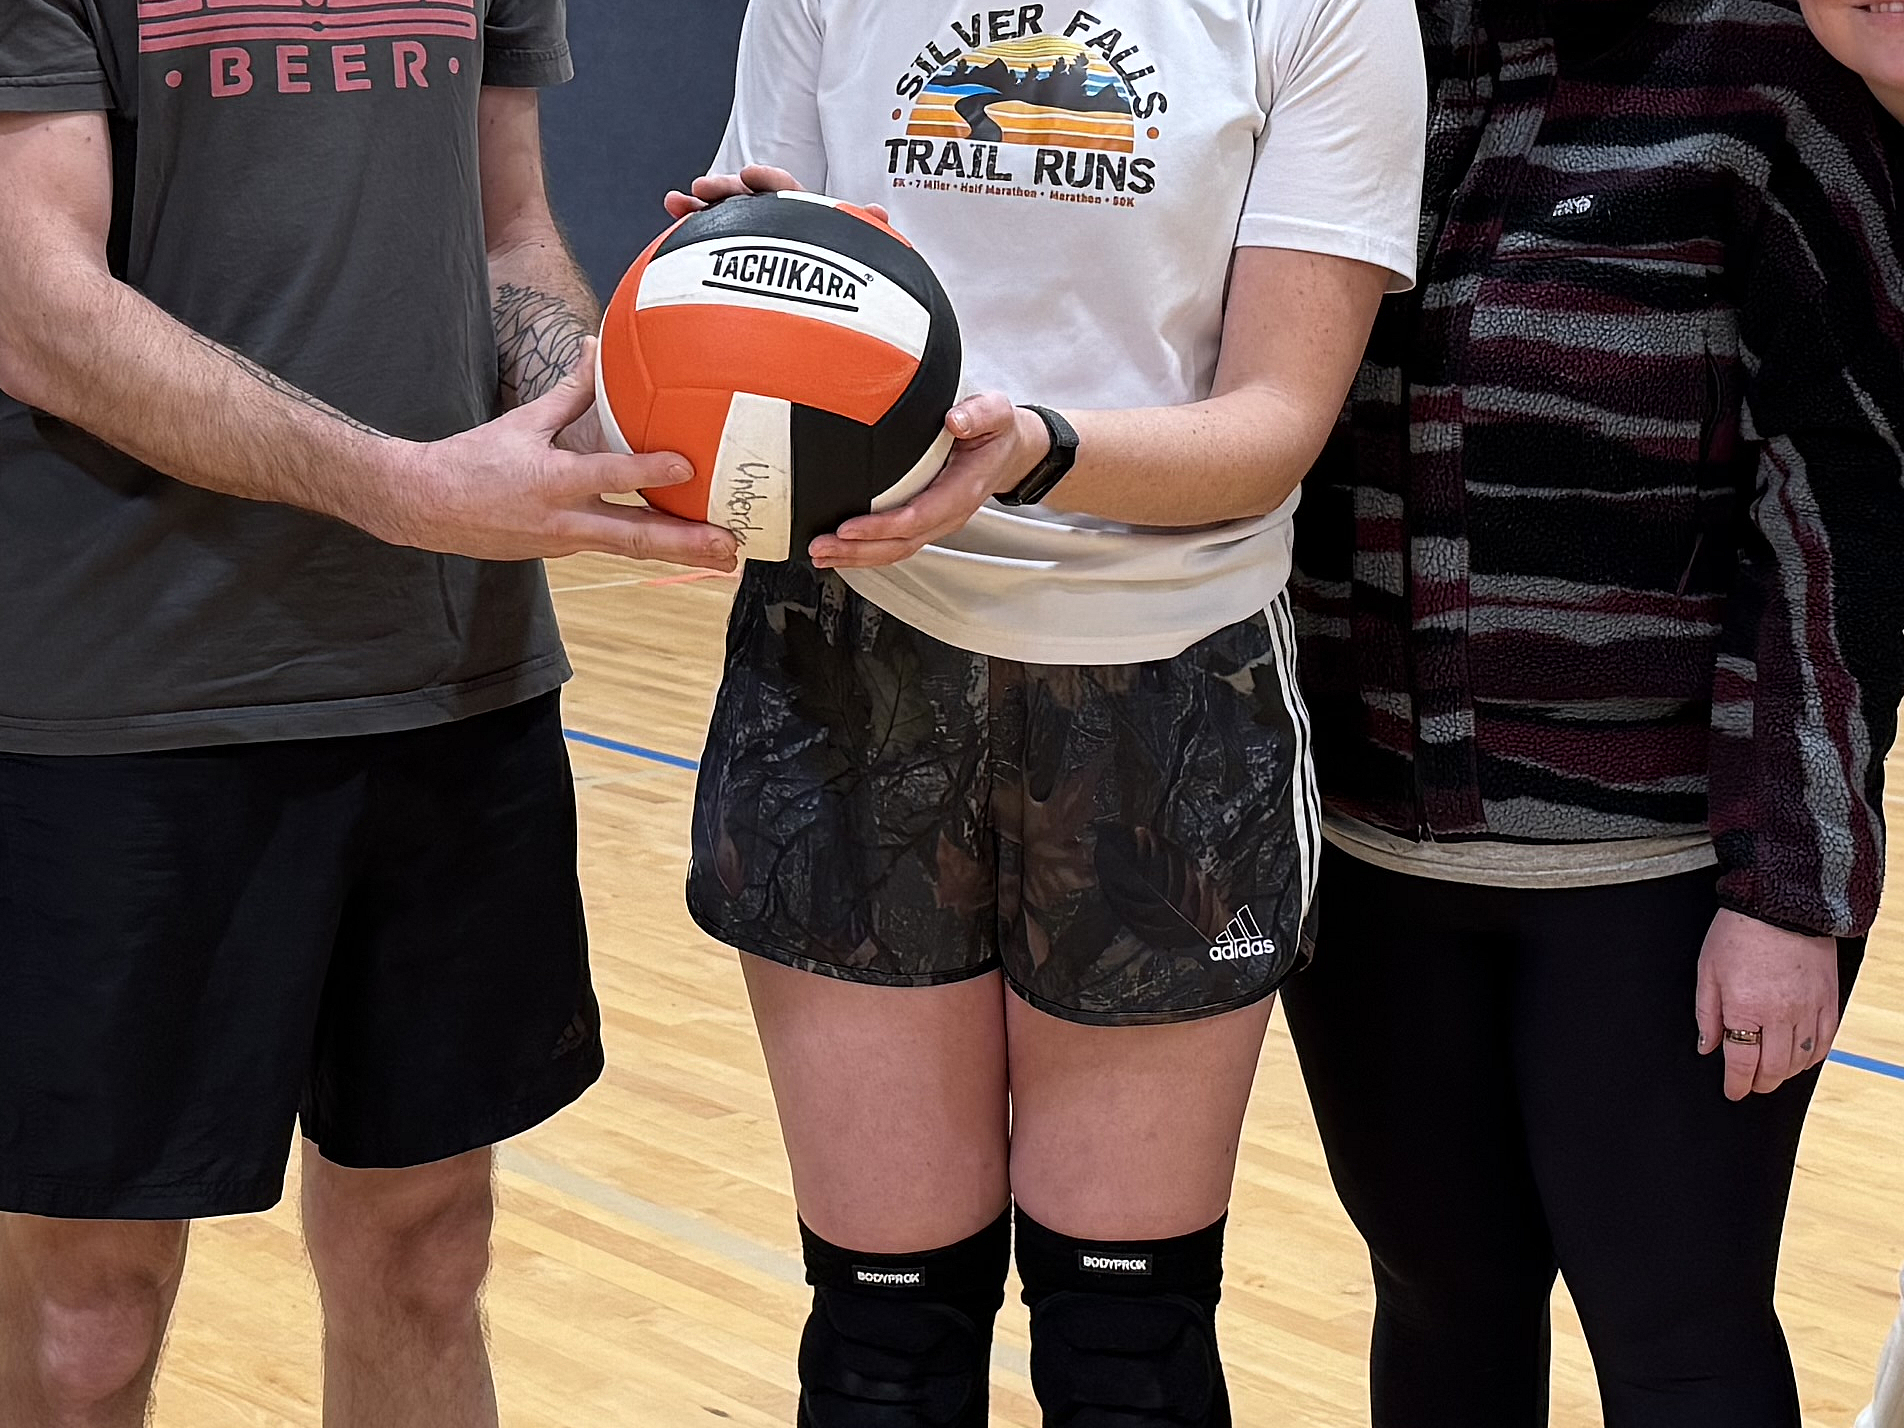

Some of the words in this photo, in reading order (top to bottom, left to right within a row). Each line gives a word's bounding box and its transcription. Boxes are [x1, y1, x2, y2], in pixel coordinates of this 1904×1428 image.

[210, 40, 428, 99] BEER
[895, 2, 1045, 102] SILVER
[1062, 8, 1168, 120] FALLS
[884, 137, 1012, 183] TRAIL
[1033, 148, 1157, 195] RUNS
[915, 179, 921, 189] 7
[923, 179, 951, 191] Miler
[960, 182, 983, 194] Half
[985, 184, 1038, 199] Marathon
[1049, 190, 1102, 205] Marathon
[709, 246, 857, 301] TACHIKARA
[1208, 937, 1276, 962] adidas
[857, 1270, 920, 1284] BODYPROX
[1082, 1254, 1147, 1271] BODYPROX
